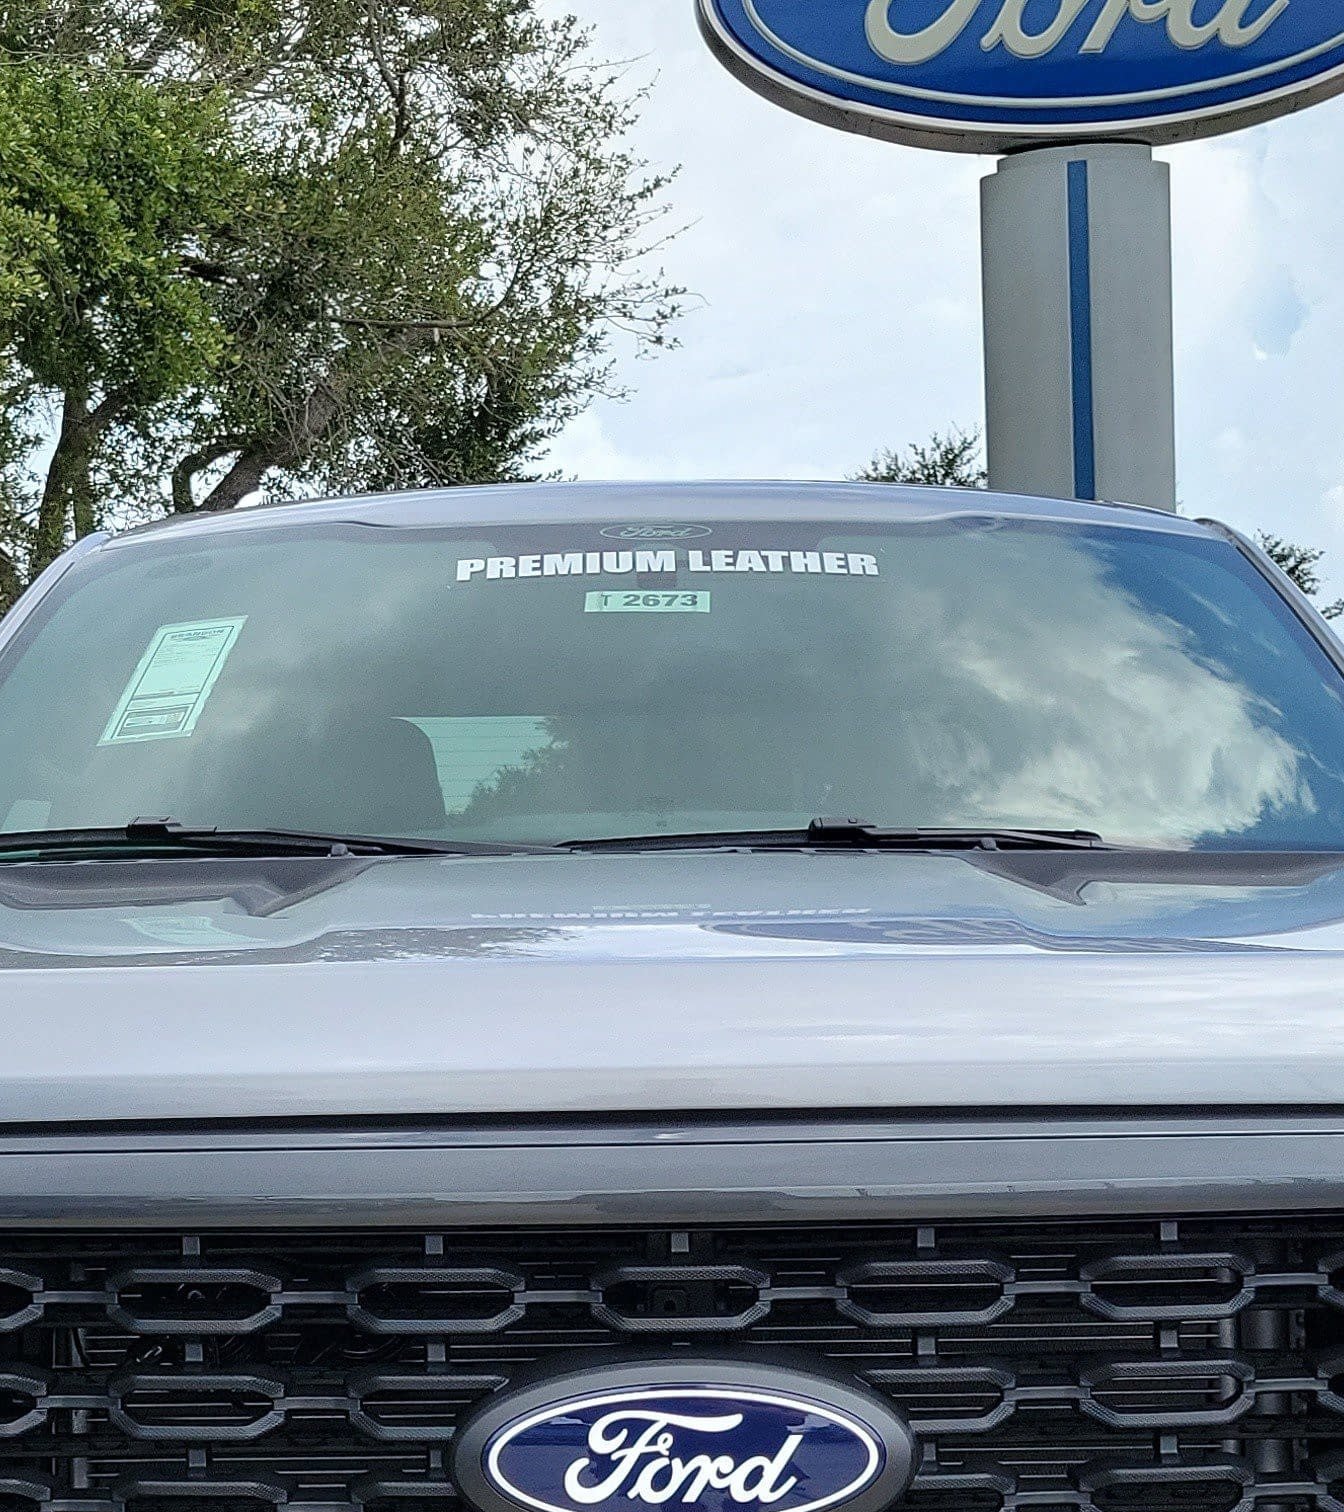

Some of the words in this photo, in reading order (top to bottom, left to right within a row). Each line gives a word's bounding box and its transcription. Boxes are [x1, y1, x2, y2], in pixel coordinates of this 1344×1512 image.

[620, 525, 692, 538] Ford
[456, 550, 676, 581] PREMIUM
[688, 549, 879, 576] LEATHER
[623, 594, 698, 607] 2673
[564, 1409, 804, 1504] Ford
